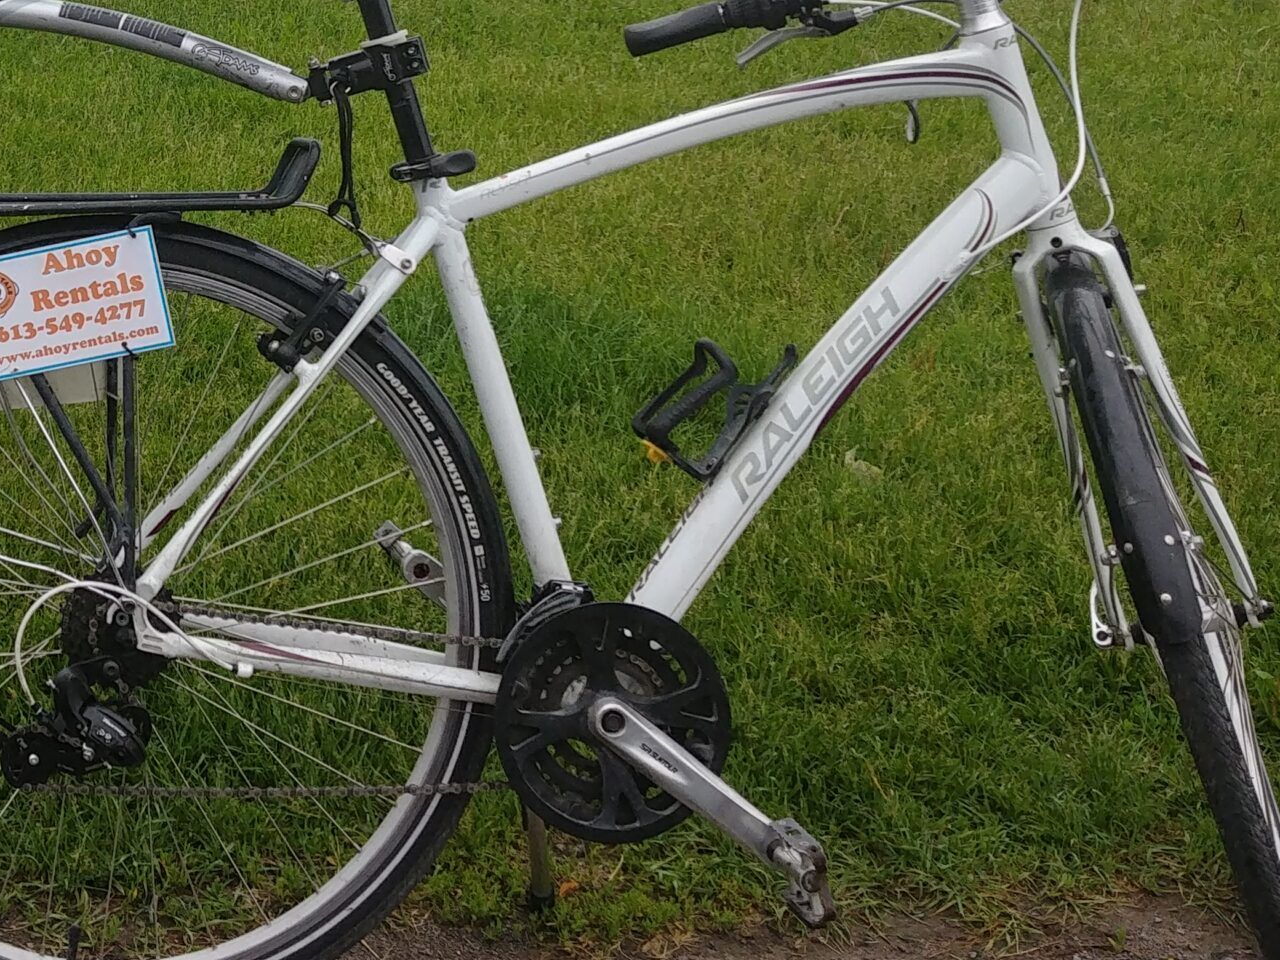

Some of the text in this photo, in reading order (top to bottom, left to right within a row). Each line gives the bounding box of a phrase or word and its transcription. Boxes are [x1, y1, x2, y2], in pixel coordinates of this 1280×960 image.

[29, 272, 146, 313] Rentals
[41, 243, 121, 276] Ahoy
[730, 285, 901, 506] RALEIGH
[375, 362, 437, 434] GOODYEAR
[432, 436, 467, 493] TRANSIT
[458, 495, 481, 540] SPEED
